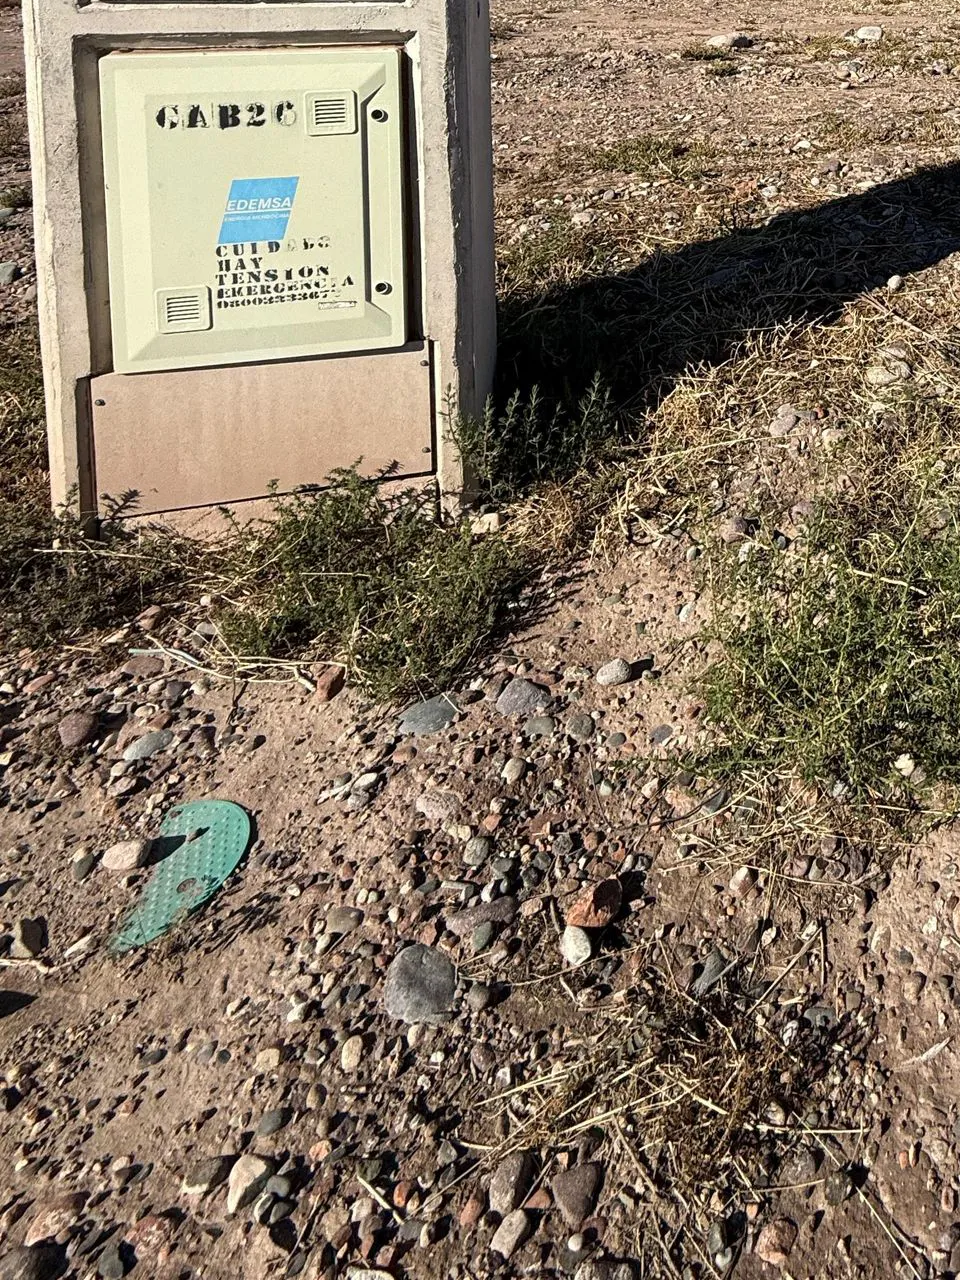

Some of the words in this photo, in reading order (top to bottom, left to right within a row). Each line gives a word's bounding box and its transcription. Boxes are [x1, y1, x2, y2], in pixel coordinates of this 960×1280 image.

[227, 197, 292, 211] EDEMSA
[217, 257, 263, 272] HAY
[215, 265, 330, 286] TENSION
